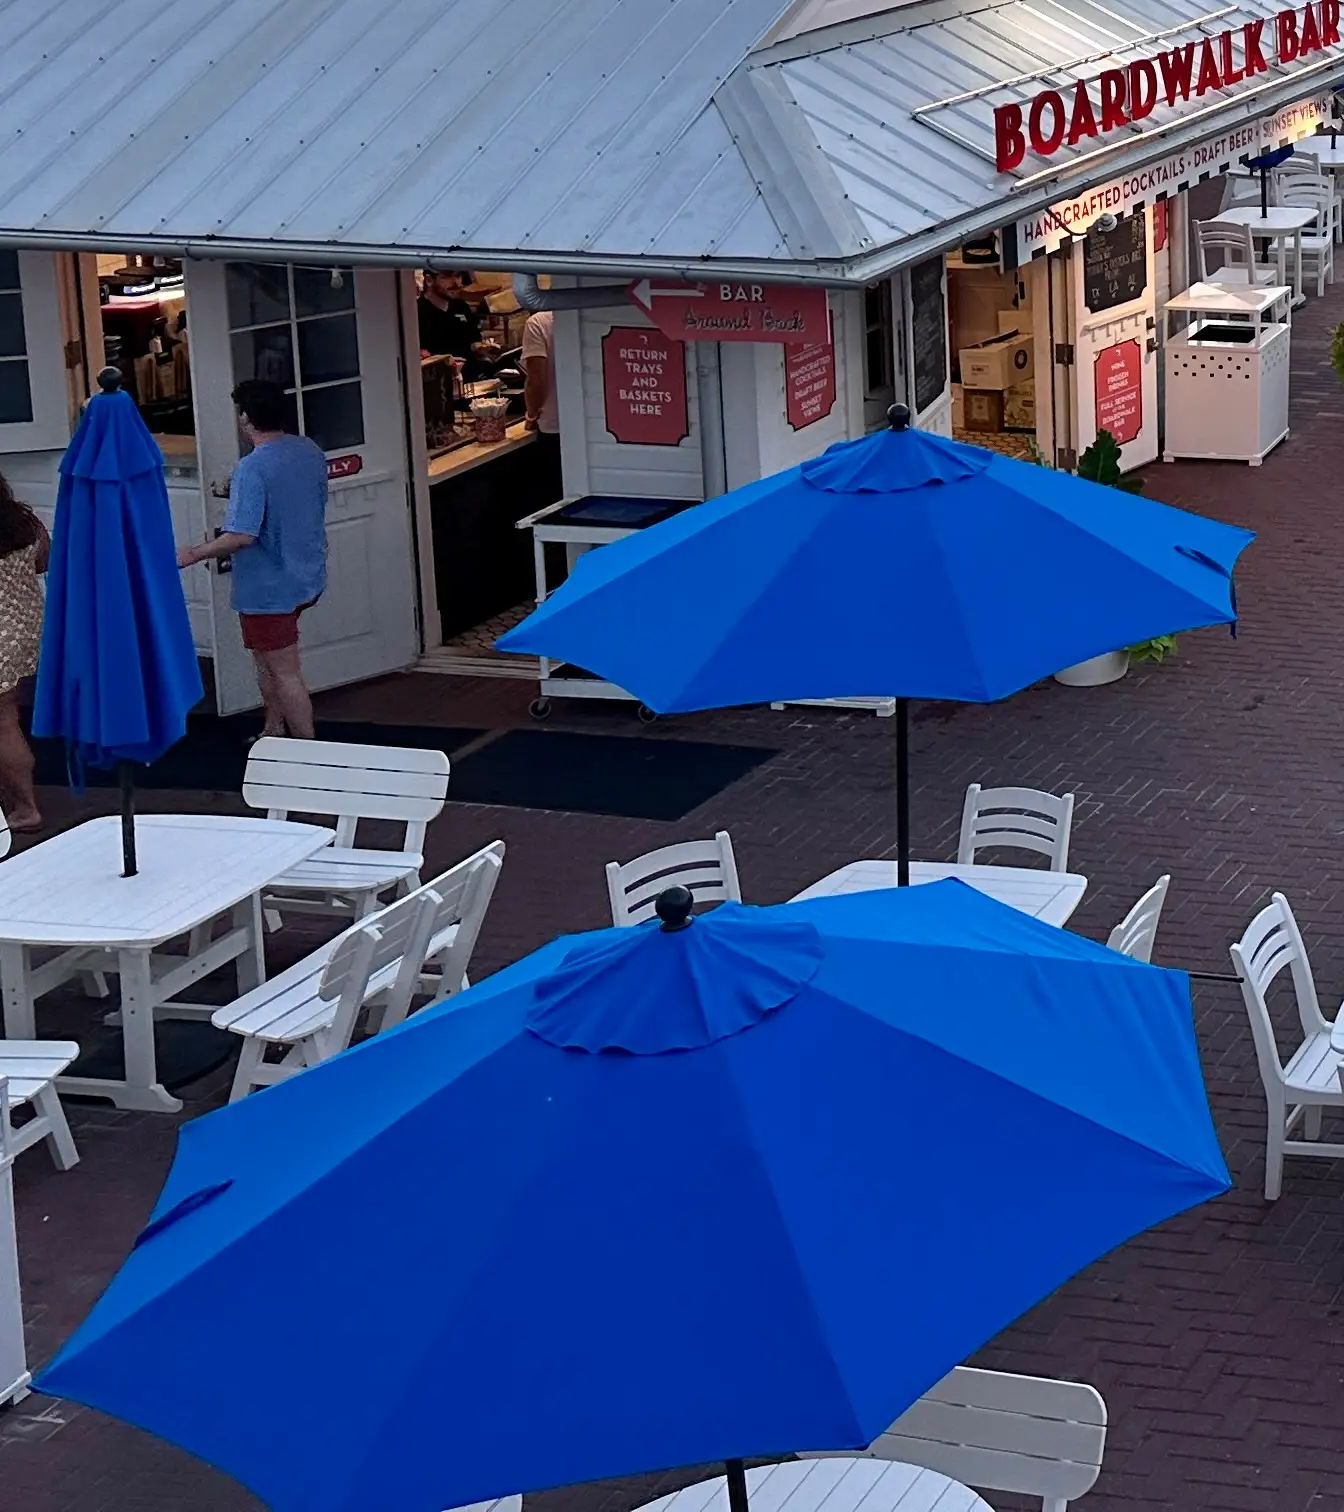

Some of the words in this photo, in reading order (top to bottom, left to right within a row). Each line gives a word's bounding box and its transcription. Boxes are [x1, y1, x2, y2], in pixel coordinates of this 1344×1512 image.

[994, 17, 1268, 173] BOARDWALK
[1024, 186, 1120, 243] HANDCRAFTED
[1123, 157, 1185, 199] COCKTAILS
[1193, 139, 1226, 168] DRAFT
[1229, 128, 1253, 151] BEER
[1262, 110, 1299, 138] SUNSET
[1299, 101, 1328, 120] VIEWS
[719, 284, 764, 302] BAR
[685, 307, 753, 331] Around
[761, 307, 806, 332] Back
[619, 348, 667, 360] RETURN
[626, 362, 663, 374] TRAYS
[631, 377, 658, 388] AND
[619, 389, 671, 402] BASKETS
[630, 404, 662, 416] HERE
